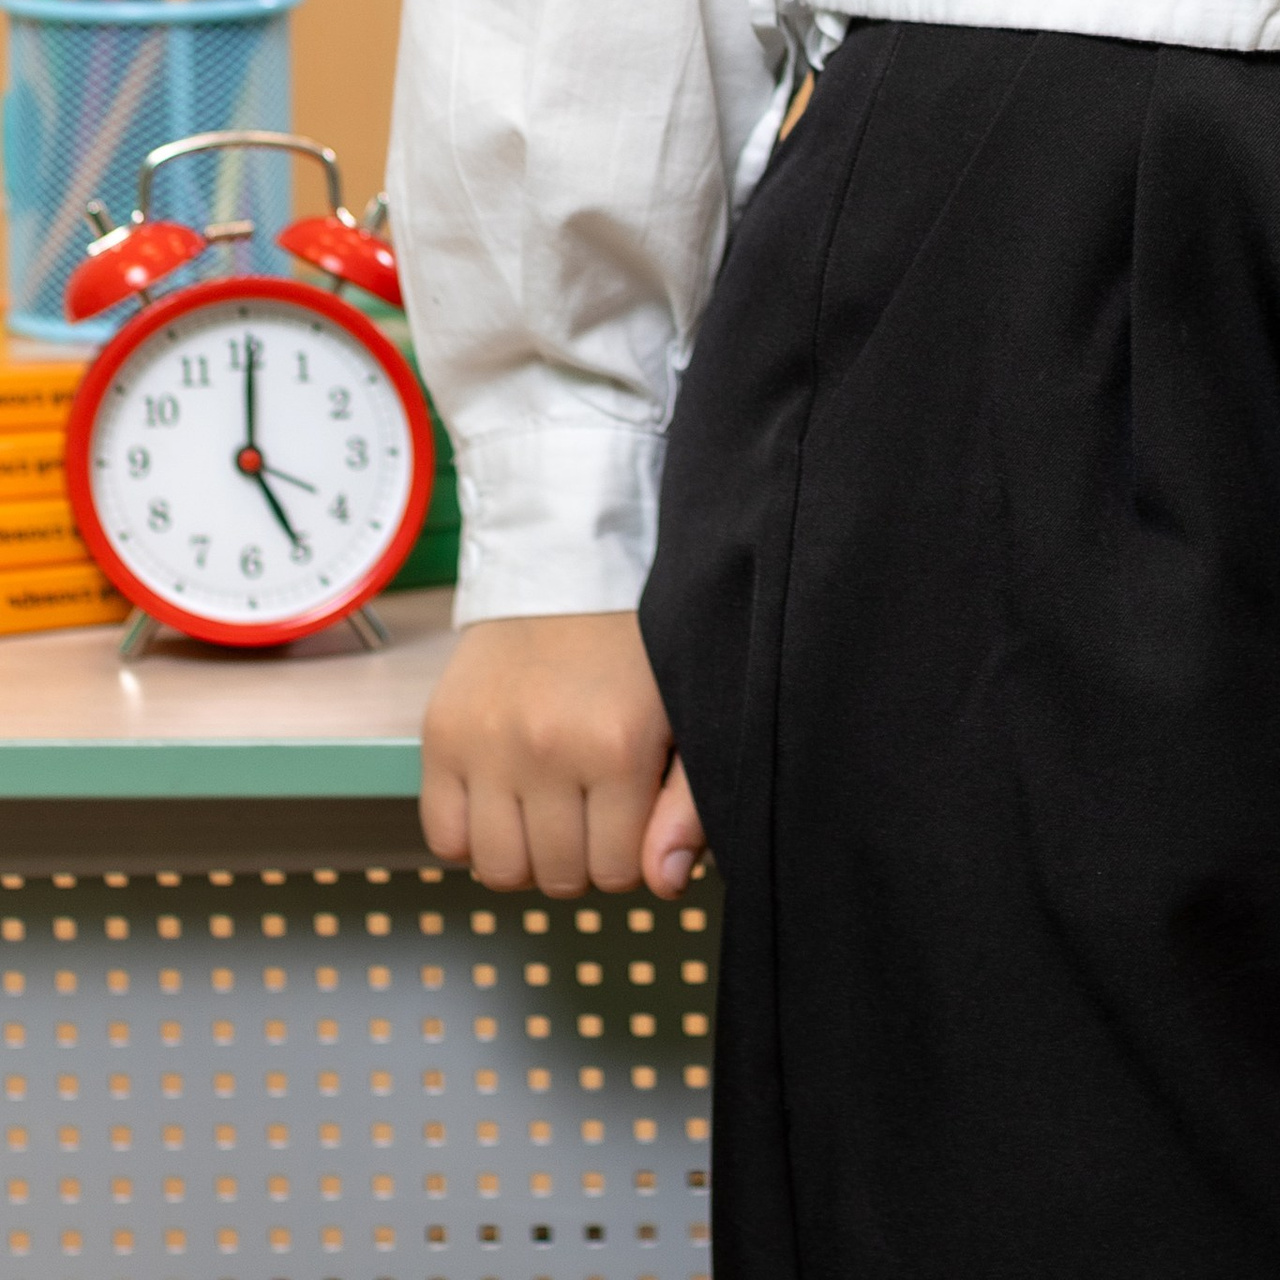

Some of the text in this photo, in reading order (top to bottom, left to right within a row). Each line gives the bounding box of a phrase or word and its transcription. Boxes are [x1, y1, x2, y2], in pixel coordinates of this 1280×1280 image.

[181, 355, 211, 387] 11
[229, 338, 264, 371] 12
[295, 349, 309, 382] 1
[144, 393, 180, 427] 10
[329, 386, 352, 420] 2
[127, 445, 151, 479] 9
[346, 437, 369, 471] 3
[148, 498, 172, 533] 8
[328, 492, 350, 524] 4
[188, 534, 211, 568] 7
[239, 544, 264, 579] 6
[289, 530, 313, 565] 5
